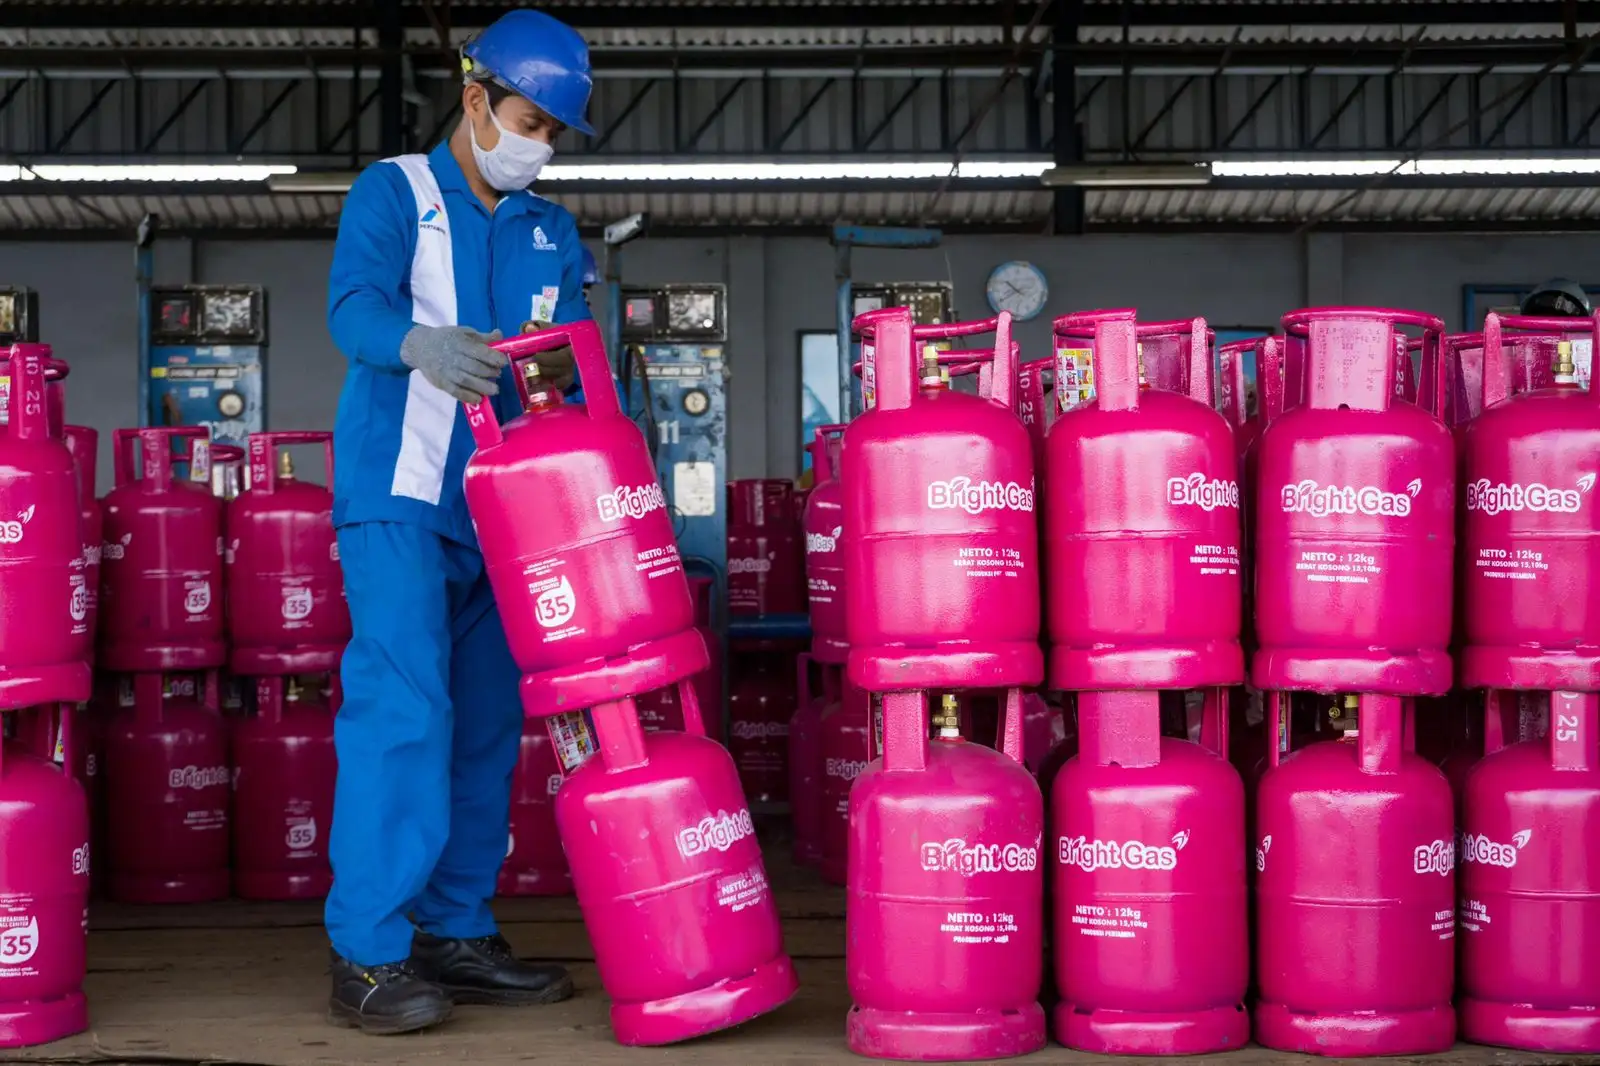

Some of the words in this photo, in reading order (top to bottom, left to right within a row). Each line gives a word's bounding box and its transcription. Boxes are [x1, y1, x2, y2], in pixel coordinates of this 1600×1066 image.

[1019, 371, 1034, 425] 10-25
[657, 420, 680, 444] 11
[927, 475, 1006, 514] Bright
[1004, 481, 1033, 513] Gas
[1167, 472, 1230, 511] Bright
[1281, 479, 1357, 517] Bright
[1357, 486, 1411, 517] Gas
[1466, 478, 1522, 516] Bright
[1521, 484, 1581, 512] Gas
[960, 548, 992, 557] NETTO
[1002, 548, 1020, 559] 12kg
[1195, 545, 1222, 554] NETTO
[1302, 552, 1336, 561] NETTO
[1348, 553, 1375, 565] 12kg
[1480, 549, 1506, 558] NETTO
[1516, 550, 1542, 561] 12kg
[537, 595, 570, 621] 135
[680, 812, 744, 857] Bright
[921, 838, 1001, 877] Bright
[1001, 843, 1037, 872] Gas
[1059, 835, 1122, 872] Bright
[1121, 839, 1177, 871] Gas
[1475, 833, 1517, 868] Gas
[722, 879, 748, 896] NETTO
[947, 912, 983, 923] NETTO
[993, 912, 1014, 924] 12kg
[1075, 905, 1104, 915] NETTO
[1115, 907, 1141, 919] 12kg
[1089, 918, 1117, 926] KOSONG
[965, 924, 995, 932] KOSONG
